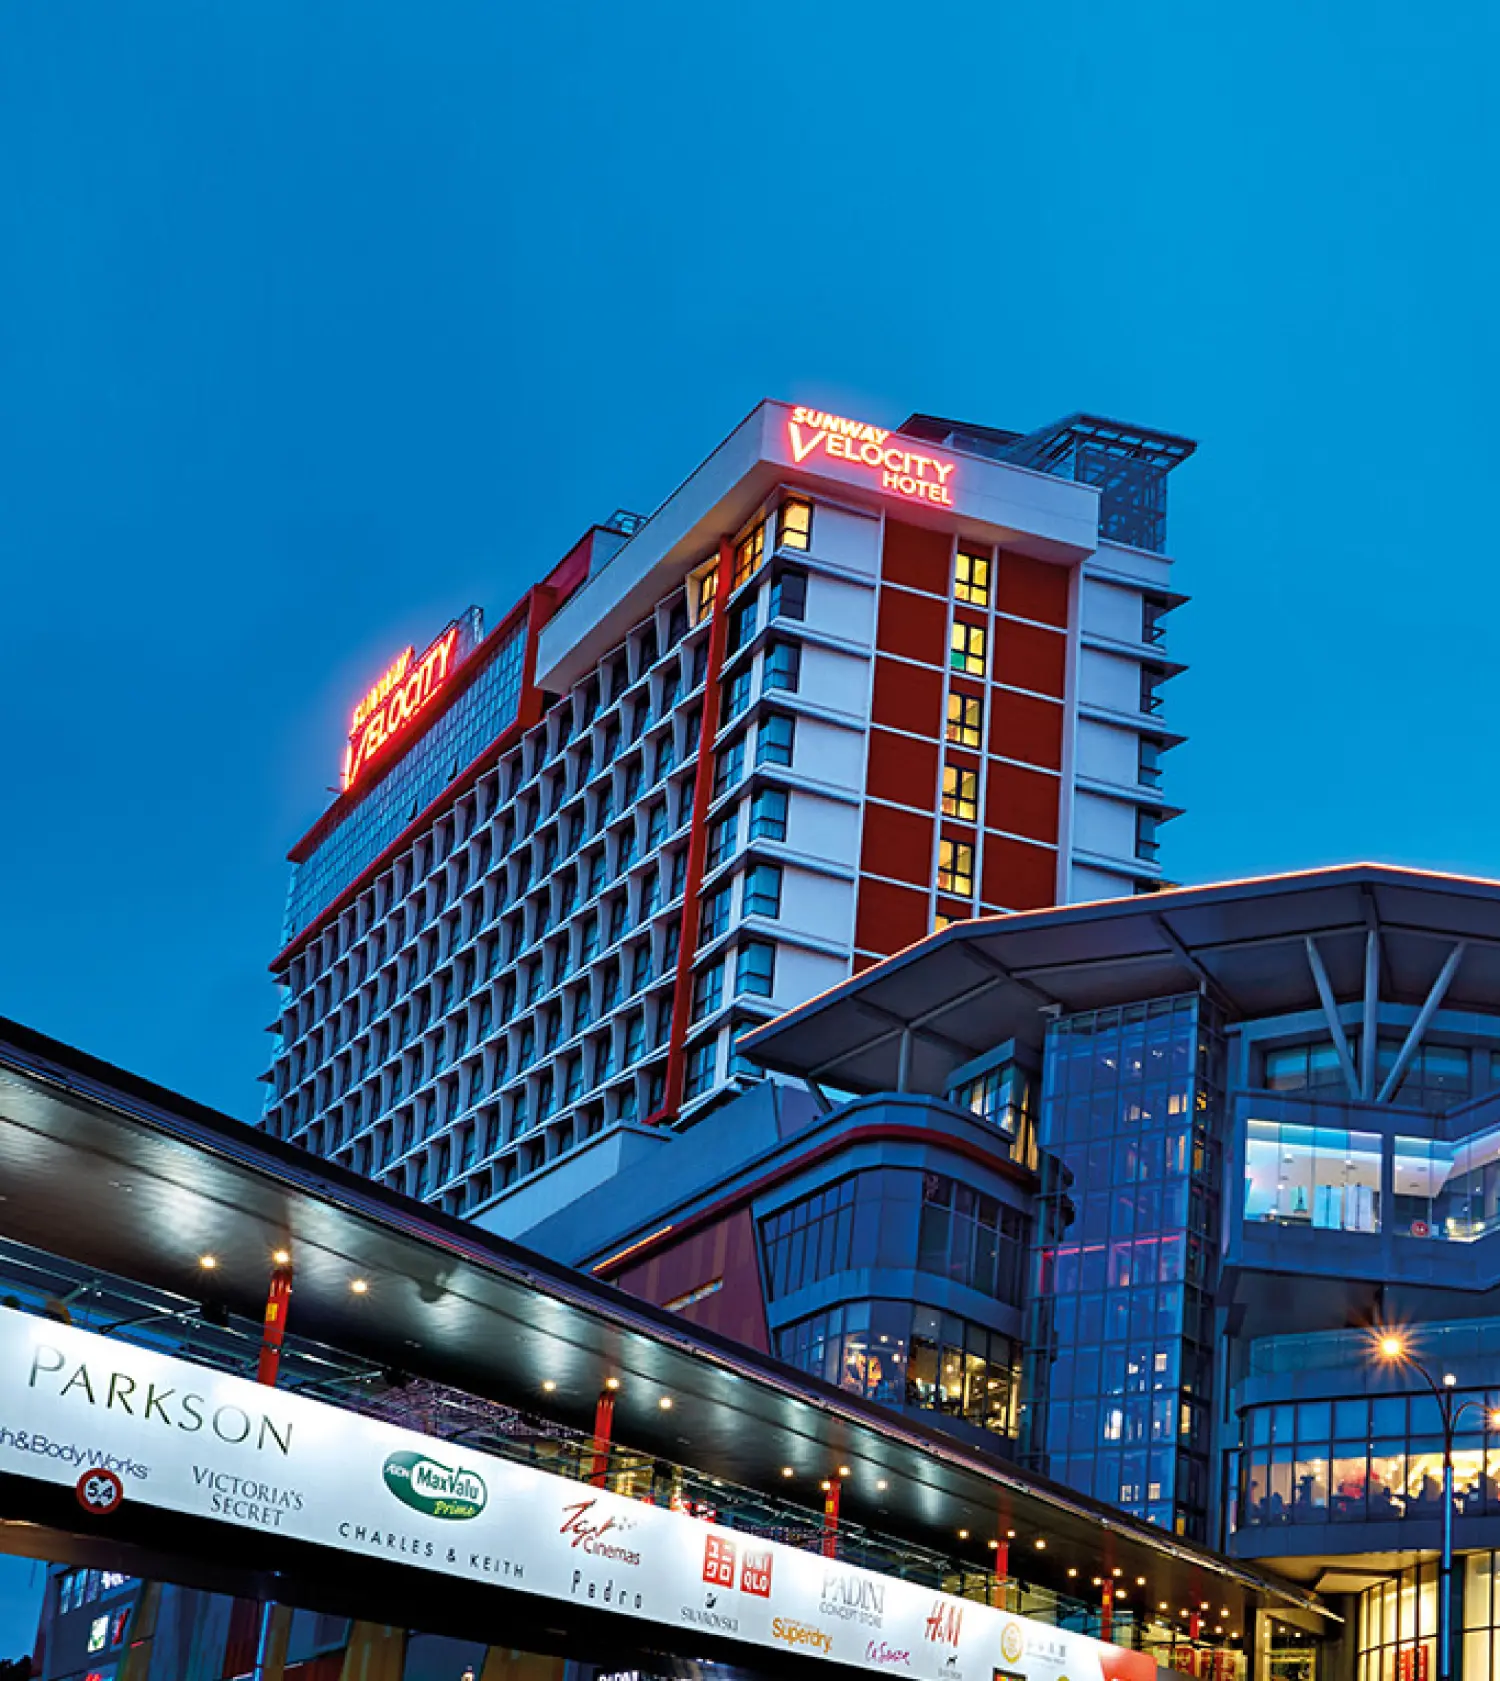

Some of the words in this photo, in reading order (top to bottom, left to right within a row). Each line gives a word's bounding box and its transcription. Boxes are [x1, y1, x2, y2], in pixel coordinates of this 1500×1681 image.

[792, 406, 890, 444] SUNWAY
[788, 421, 955, 483] VELOCITY
[882, 470, 953, 504] HOTEL
[28, 1345, 293, 1456] PARKSON
[193, 1465, 304, 1511] VICTORIA'S
[416, 1466, 480, 1500] MaxValu
[210, 1492, 284, 1527] SECRET
[338, 1522, 434, 1558] CHARLES
[446, 1548, 456, 1563] &
[470, 1553, 525, 1579] KEITH
[583, 1536, 640, 1565] Cinemas
[571, 1569, 642, 1609] Pedro
[925, 1600, 964, 1648] H&M
